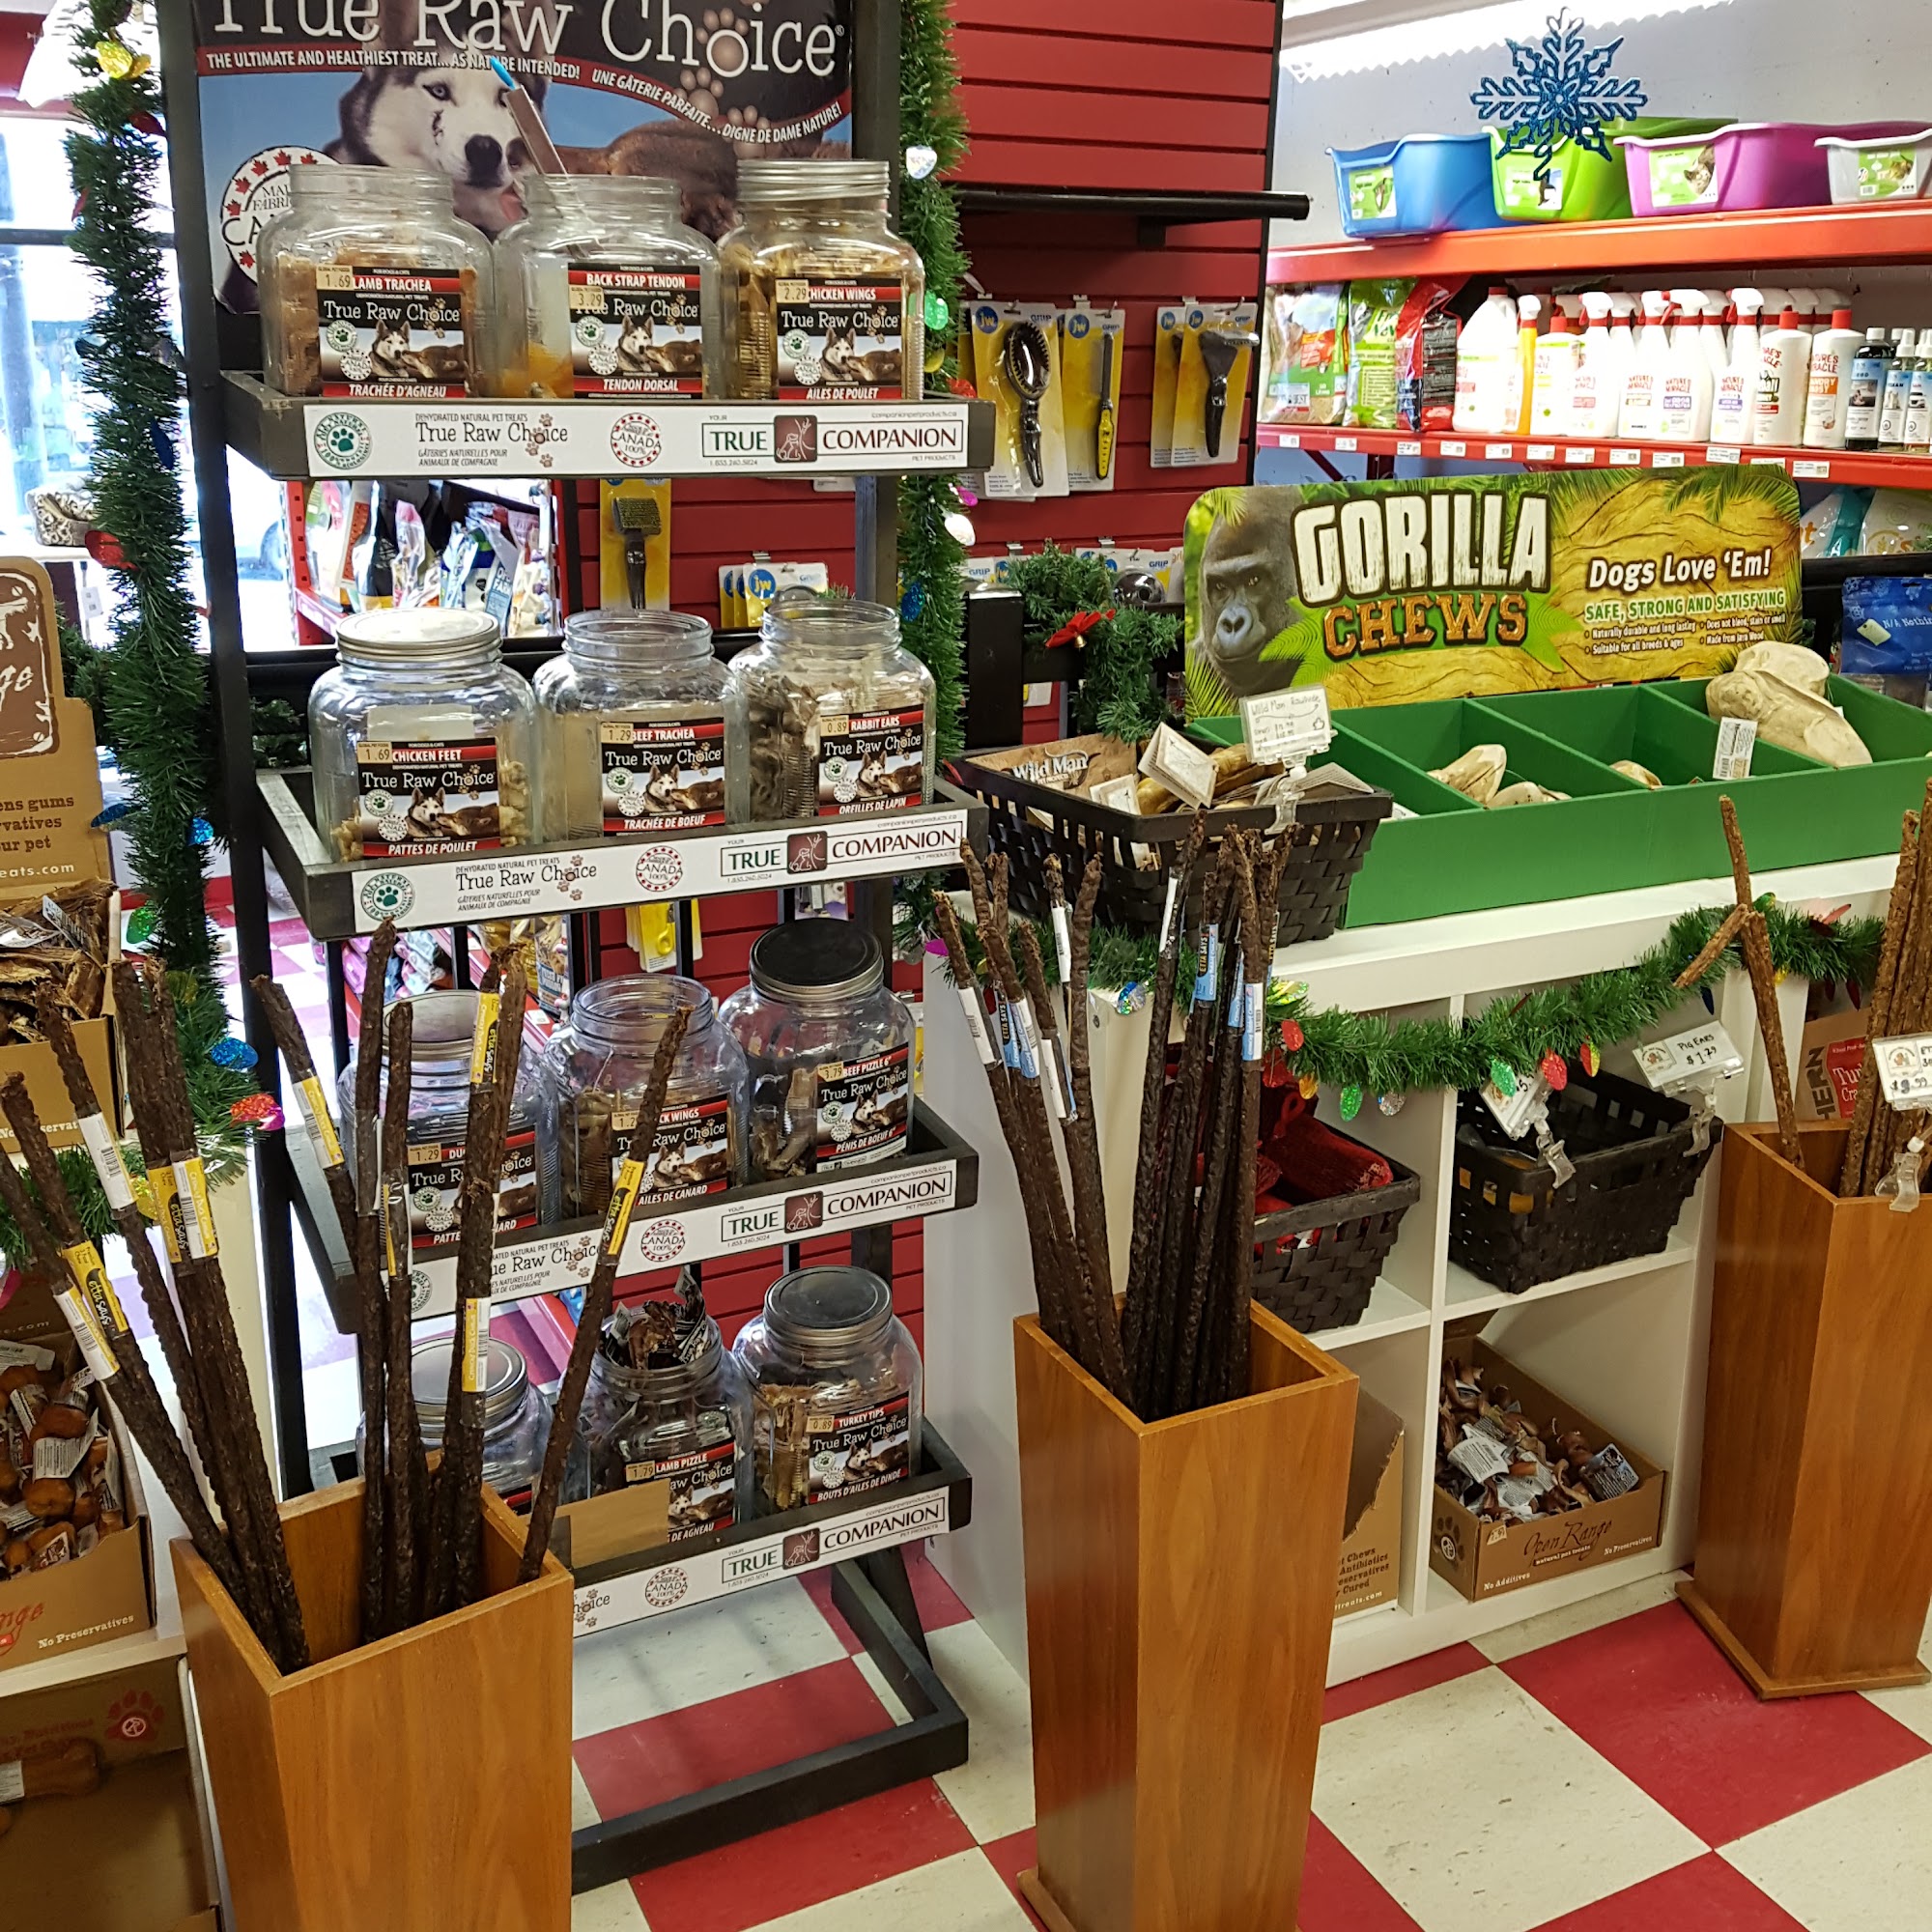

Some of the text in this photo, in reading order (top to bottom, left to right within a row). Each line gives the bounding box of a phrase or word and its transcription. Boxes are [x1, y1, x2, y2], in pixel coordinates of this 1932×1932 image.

[207, 52, 231, 69] THE
[234, 50, 295, 68] ULTIMATE
[298, 50, 325, 66] AND
[327, 50, 398, 67] HEALTHIEST
[451, 53, 467, 69] AS
[518, 57, 581, 79] INTENDED!
[592, 69, 615, 84] UNE
[616, 74, 663, 102] GÂTERIE
[723, 123, 757, 142] DIGNE
[757, 128, 771, 143] DE
[773, 126, 802, 143] DAME
[802, 101, 842, 137] NATURE!
[326, 273, 351, 288] 1.69
[353, 277, 433, 292] LAMB TRACHEA
[586, 273, 686, 289] BACK STRAP TENDON
[579, 293, 602, 307] 3.29
[845, 288, 876, 300] WINGS
[324, 300, 460, 323] True Raw Choice
[613, 298, 646, 316] Raw
[650, 299, 698, 318] Choice
[781, 310, 898, 328] True Raw Choice
[1031, 314, 1052, 323] GRIP
[349, 383, 446, 398] TRACHÉE D'AGNEAU
[603, 378, 678, 391] TENDON DORSAL
[807, 387, 879, 400] AILES DE POULET
[415, 412, 528, 422] DEHYDRATED NATURAL PET TREATS
[415, 421, 568, 444] True Raw Choice
[611, 431, 662, 450] CANADA
[710, 428, 956, 451] TRUE COMPANION
[451, 458, 461, 468] DE
[1294, 494, 1548, 604] GORILLA
[1590, 559, 1655, 591] Dogs
[1663, 554, 1716, 582] Love
[1585, 590, 1785, 623] SAFE, STRONG AND SATISFYING
[1323, 592, 1528, 658] CHEWS
[1593, 621, 1696, 639] Naturally durable and long lasting
[1707, 619, 1720, 629] Does
[1721, 618, 1730, 628] not
[1764, 616, 1771, 625] or
[1593, 641, 1620, 655] Suitable
[1620, 640, 1631, 652] for
[1642, 639, 1662, 651] breeds
[1670, 639, 1684, 651] ages
[1707, 634, 1721, 645] Made
[1722, 633, 1735, 643] from
[827, 722, 847, 733] 0.89
[850, 716, 900, 731] RABBIT EARS
[609, 729, 631, 741] 1.29
[632, 727, 695, 742] BEEF TRACHEA
[365, 748, 390, 760] 1.69
[392, 749, 462, 762] CHICKEN FEET
[823, 738, 881, 756] True Raw
[605, 749, 721, 766] True Raw Choice
[1012, 754, 1089, 783] Wild Man
[361, 771, 494, 788] True Raw Choice
[28, 797, 74, 812] gums
[624, 814, 705, 830] TRACHÉE BOEUF
[24, 835, 52, 853] pet
[388, 841, 478, 856] PATTES DE POULET
[727, 828, 957, 870] TRUE COMPANION
[456, 864, 597, 891] True Raw Choice
[637, 862, 683, 876] CANADA
[1677, 1034, 1715, 1051] PIG EARS
[821, 1082, 873, 1102] True Raw
[671, 1109, 700, 1122] WINGS
[416, 1149, 440, 1161] 1.29
[412, 1172, 445, 1187] True
[638, 1184, 707, 1206] AILES CANARD
[728, 1178, 946, 1236] TRUE COMPANION
[641, 1234, 685, 1246] CANADA
[838, 1413, 867, 1428] TURKEY
[813, 1432, 867, 1452] True Raw
[656, 1454, 707, 1473] LAMB PIZZLE
[817, 1489, 841, 1502] BOUTS
[683, 1522, 715, 1540] AGNEAU
[729, 1504, 940, 1576] TRUE COMPANION
[1523, 1520, 1612, 1567] Open Range
[1604, 1536, 1653, 1556] No Preservatives
[1347, 1548, 1376, 1563] Chews
[1535, 1546, 1591, 1565] natural pet treats
[1339, 1553, 1388, 1576] Antibiotics
[1343, 1578, 1370, 1595] Cured
[1484, 1572, 1530, 1591] No Additives
[39, 1615, 134, 1649] No Preservatives
